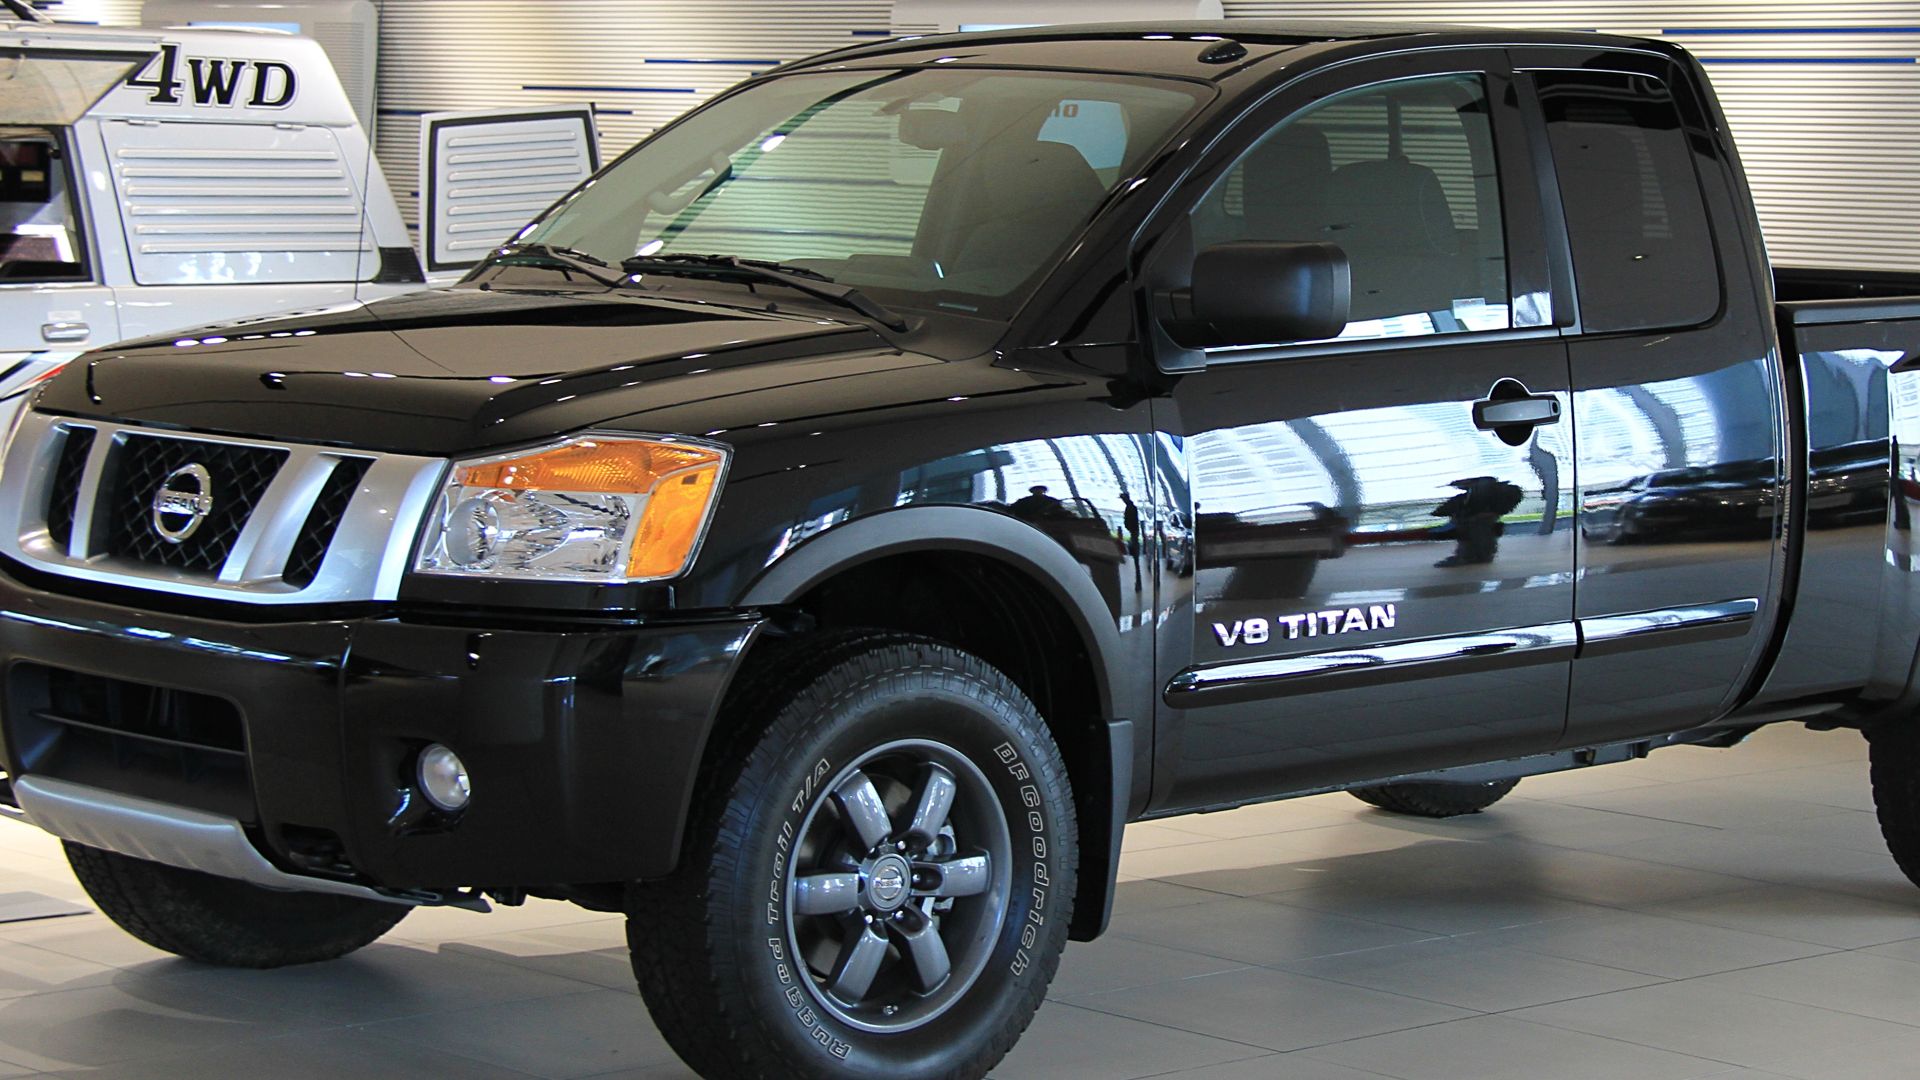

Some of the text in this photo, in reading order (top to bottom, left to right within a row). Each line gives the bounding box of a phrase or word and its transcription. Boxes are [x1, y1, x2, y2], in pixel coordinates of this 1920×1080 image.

[125, 43, 297, 108] 4WD
[1213, 603, 1396, 647] V8 TITAN
[767, 821, 794, 925] Trail
[993, 741, 1049, 977] BFGoodrich
[768, 937, 852, 1060] Rugged
